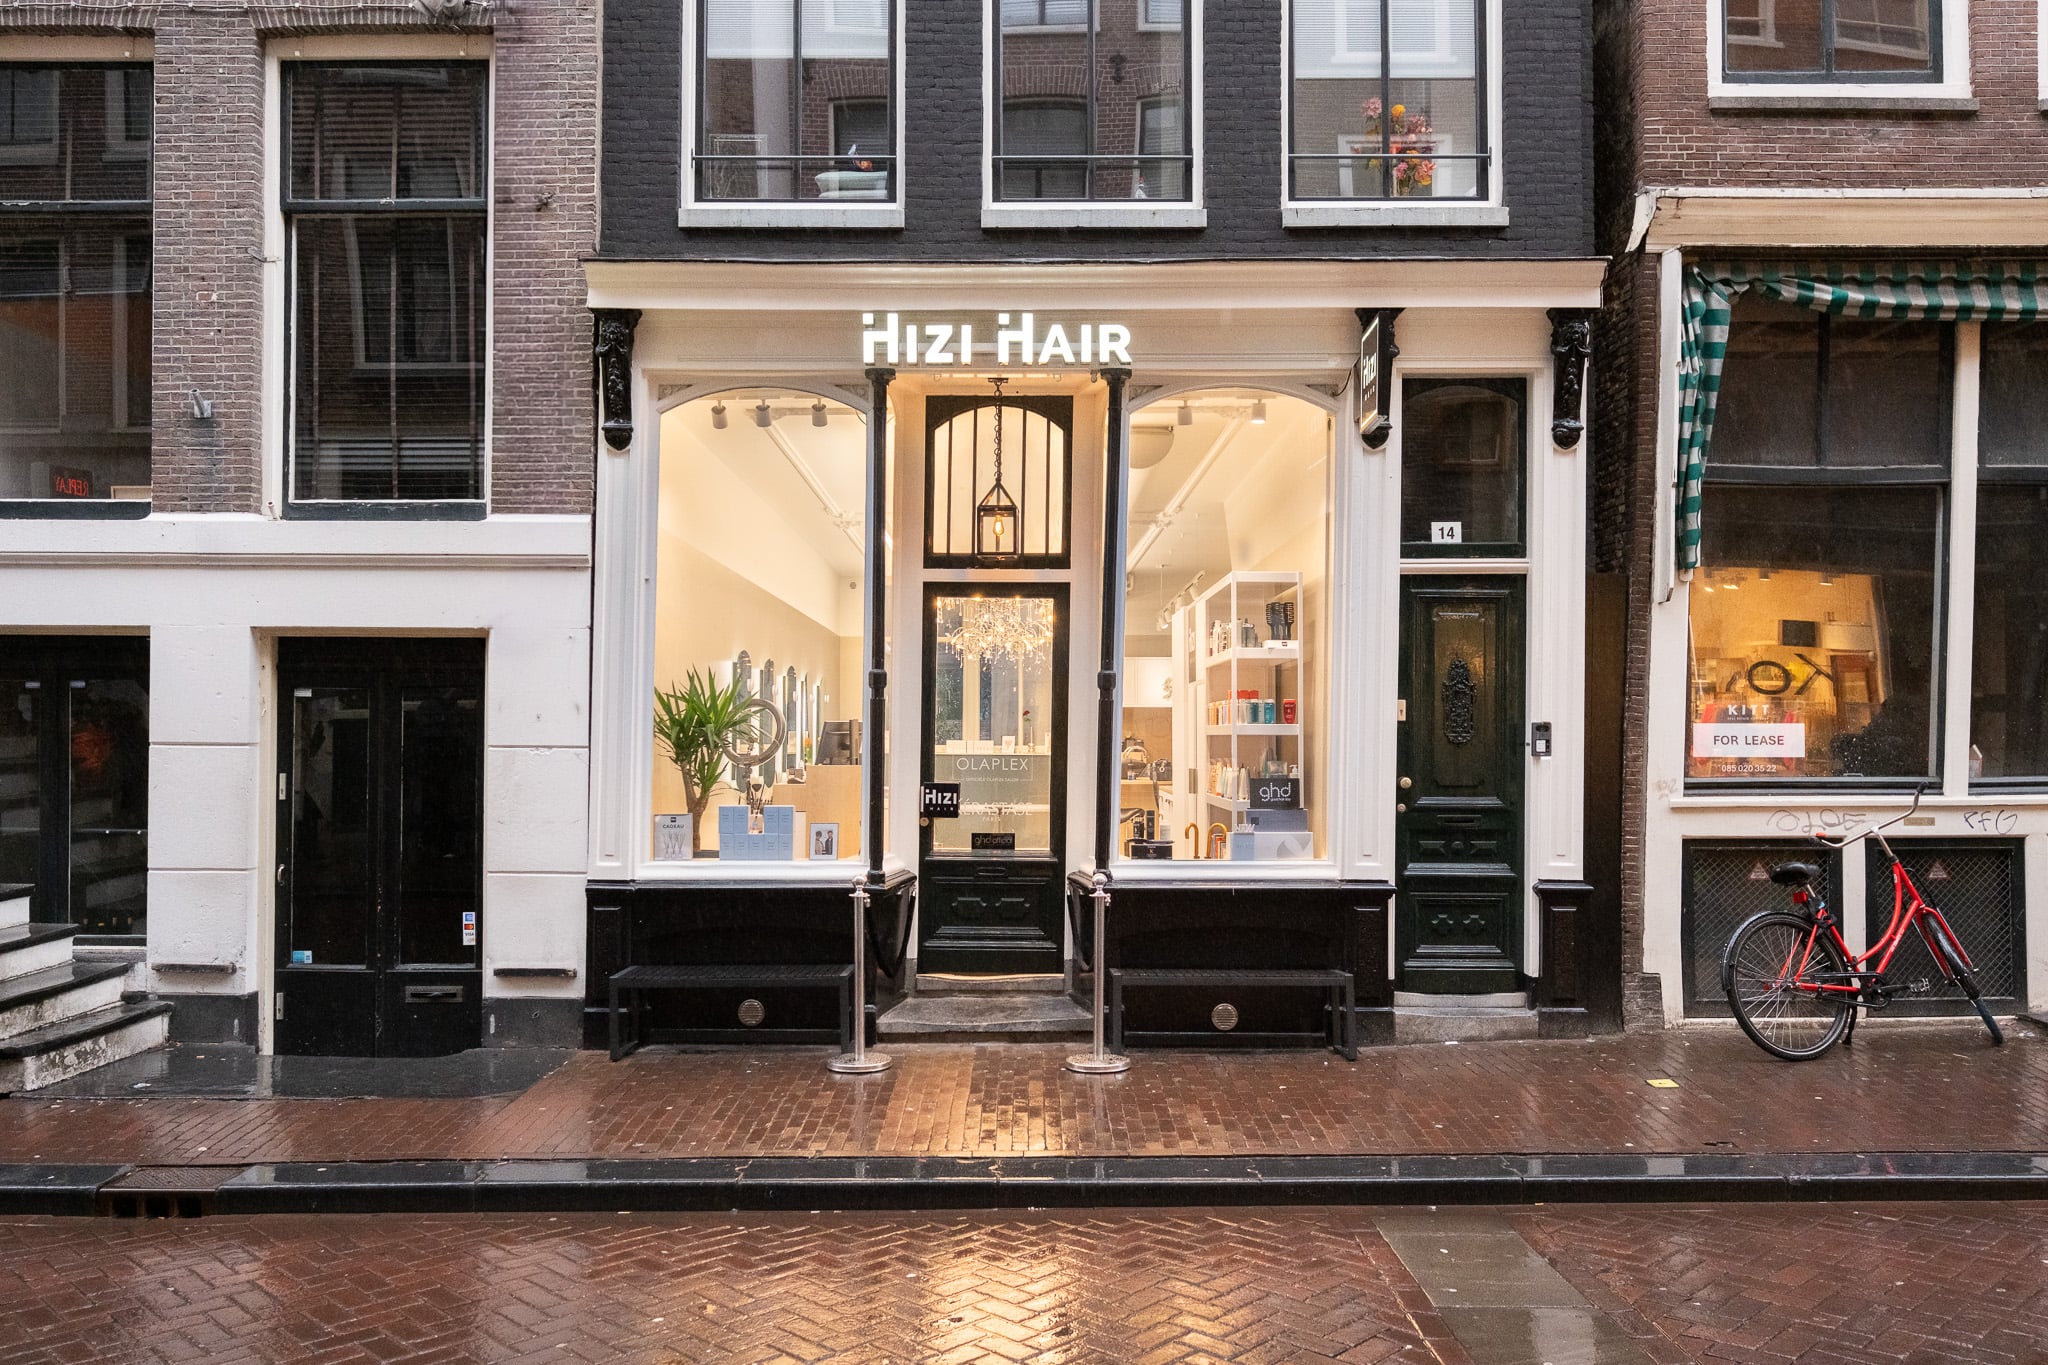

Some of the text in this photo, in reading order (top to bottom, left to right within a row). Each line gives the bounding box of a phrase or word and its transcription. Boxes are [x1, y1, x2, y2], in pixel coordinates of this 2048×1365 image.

[862, 312, 1132, 365] HIZI HAIR
[1437, 526, 1455, 539] 14
[1727, 704, 1769, 715] KITT
[1713, 735, 1784, 745] FOR LEASE
[956, 757, 1028, 770] OLAPLEX
[1721, 764, 1776, 772] 085 020 35 22
[925, 788, 957, 804] HIZI
[1259, 782, 1291, 801] ghd
